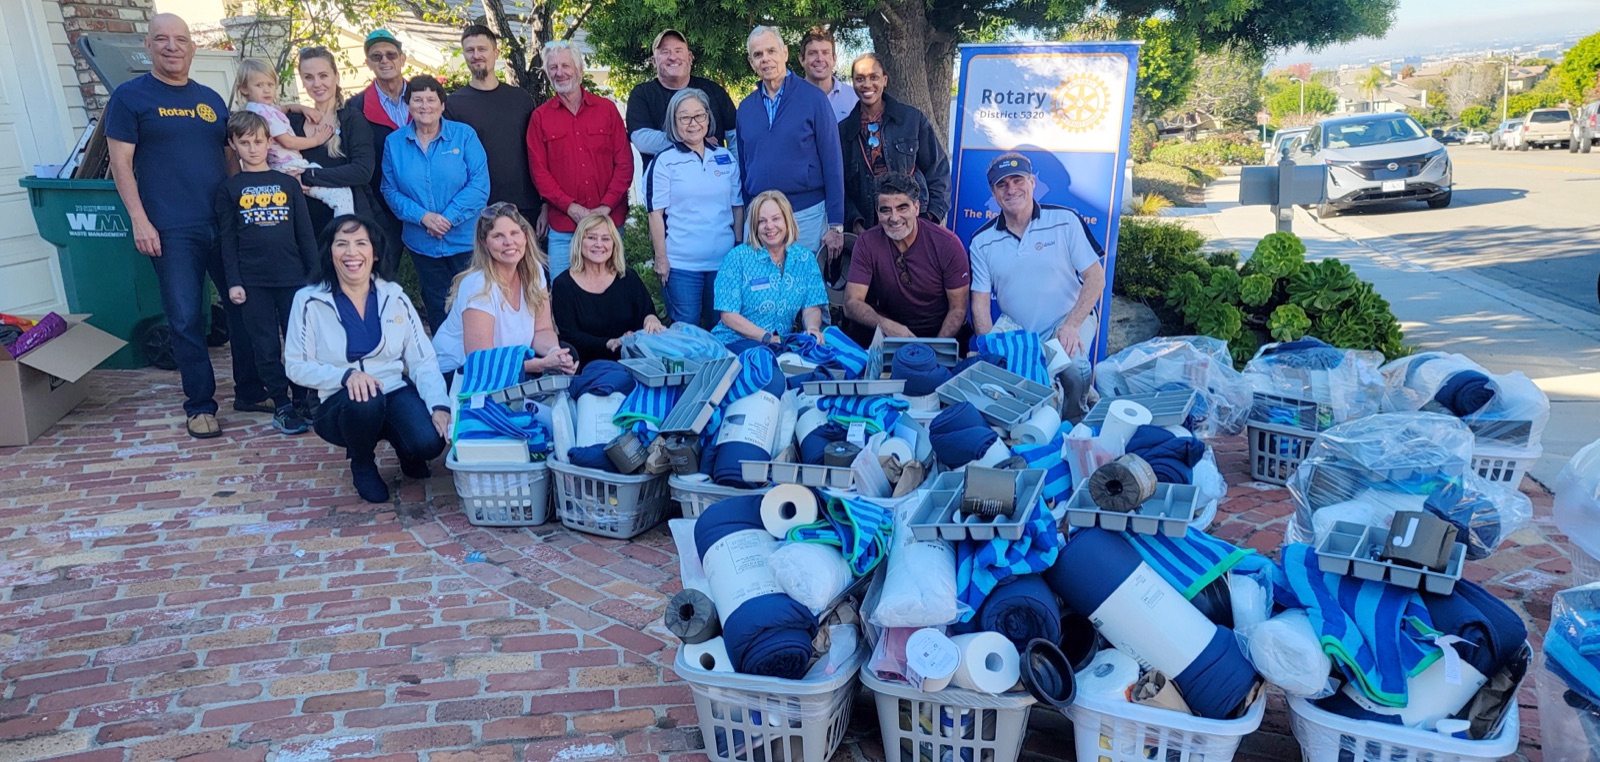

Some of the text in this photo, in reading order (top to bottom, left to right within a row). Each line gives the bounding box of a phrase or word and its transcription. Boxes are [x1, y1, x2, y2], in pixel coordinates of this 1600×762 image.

[981, 89, 1047, 109] Rotary
[158, 107, 195, 118] Rotary
[980, 111, 1044, 119] District 5320
[964, 209, 982, 218] The
[66, 213, 128, 231] WM
[1392, 517, 1419, 547] J
